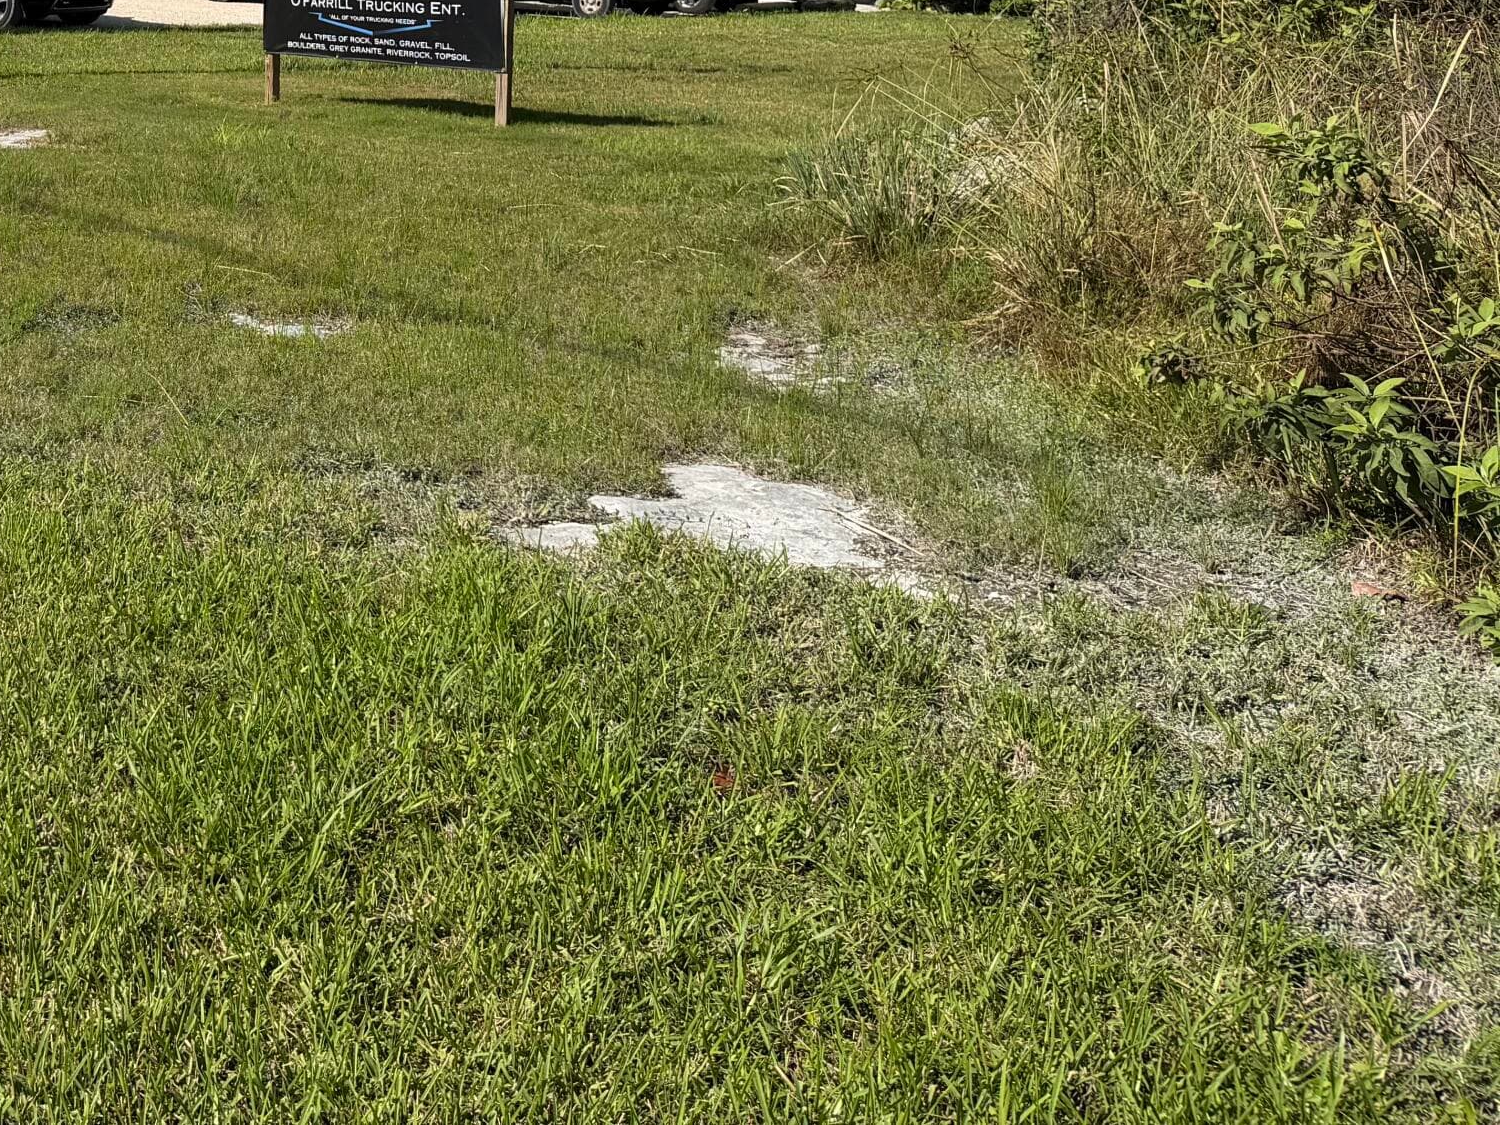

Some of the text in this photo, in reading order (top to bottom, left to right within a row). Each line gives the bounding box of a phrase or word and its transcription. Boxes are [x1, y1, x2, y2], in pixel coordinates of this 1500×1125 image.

[430, 1, 466, 16] ENT.
[366, 16, 394, 24] TRUCKING
[299, 32, 314, 40] ALL
[314, 33, 337, 42] TYPES
[338, 35, 349, 43] OF
[328, 44, 349, 52] GREY
